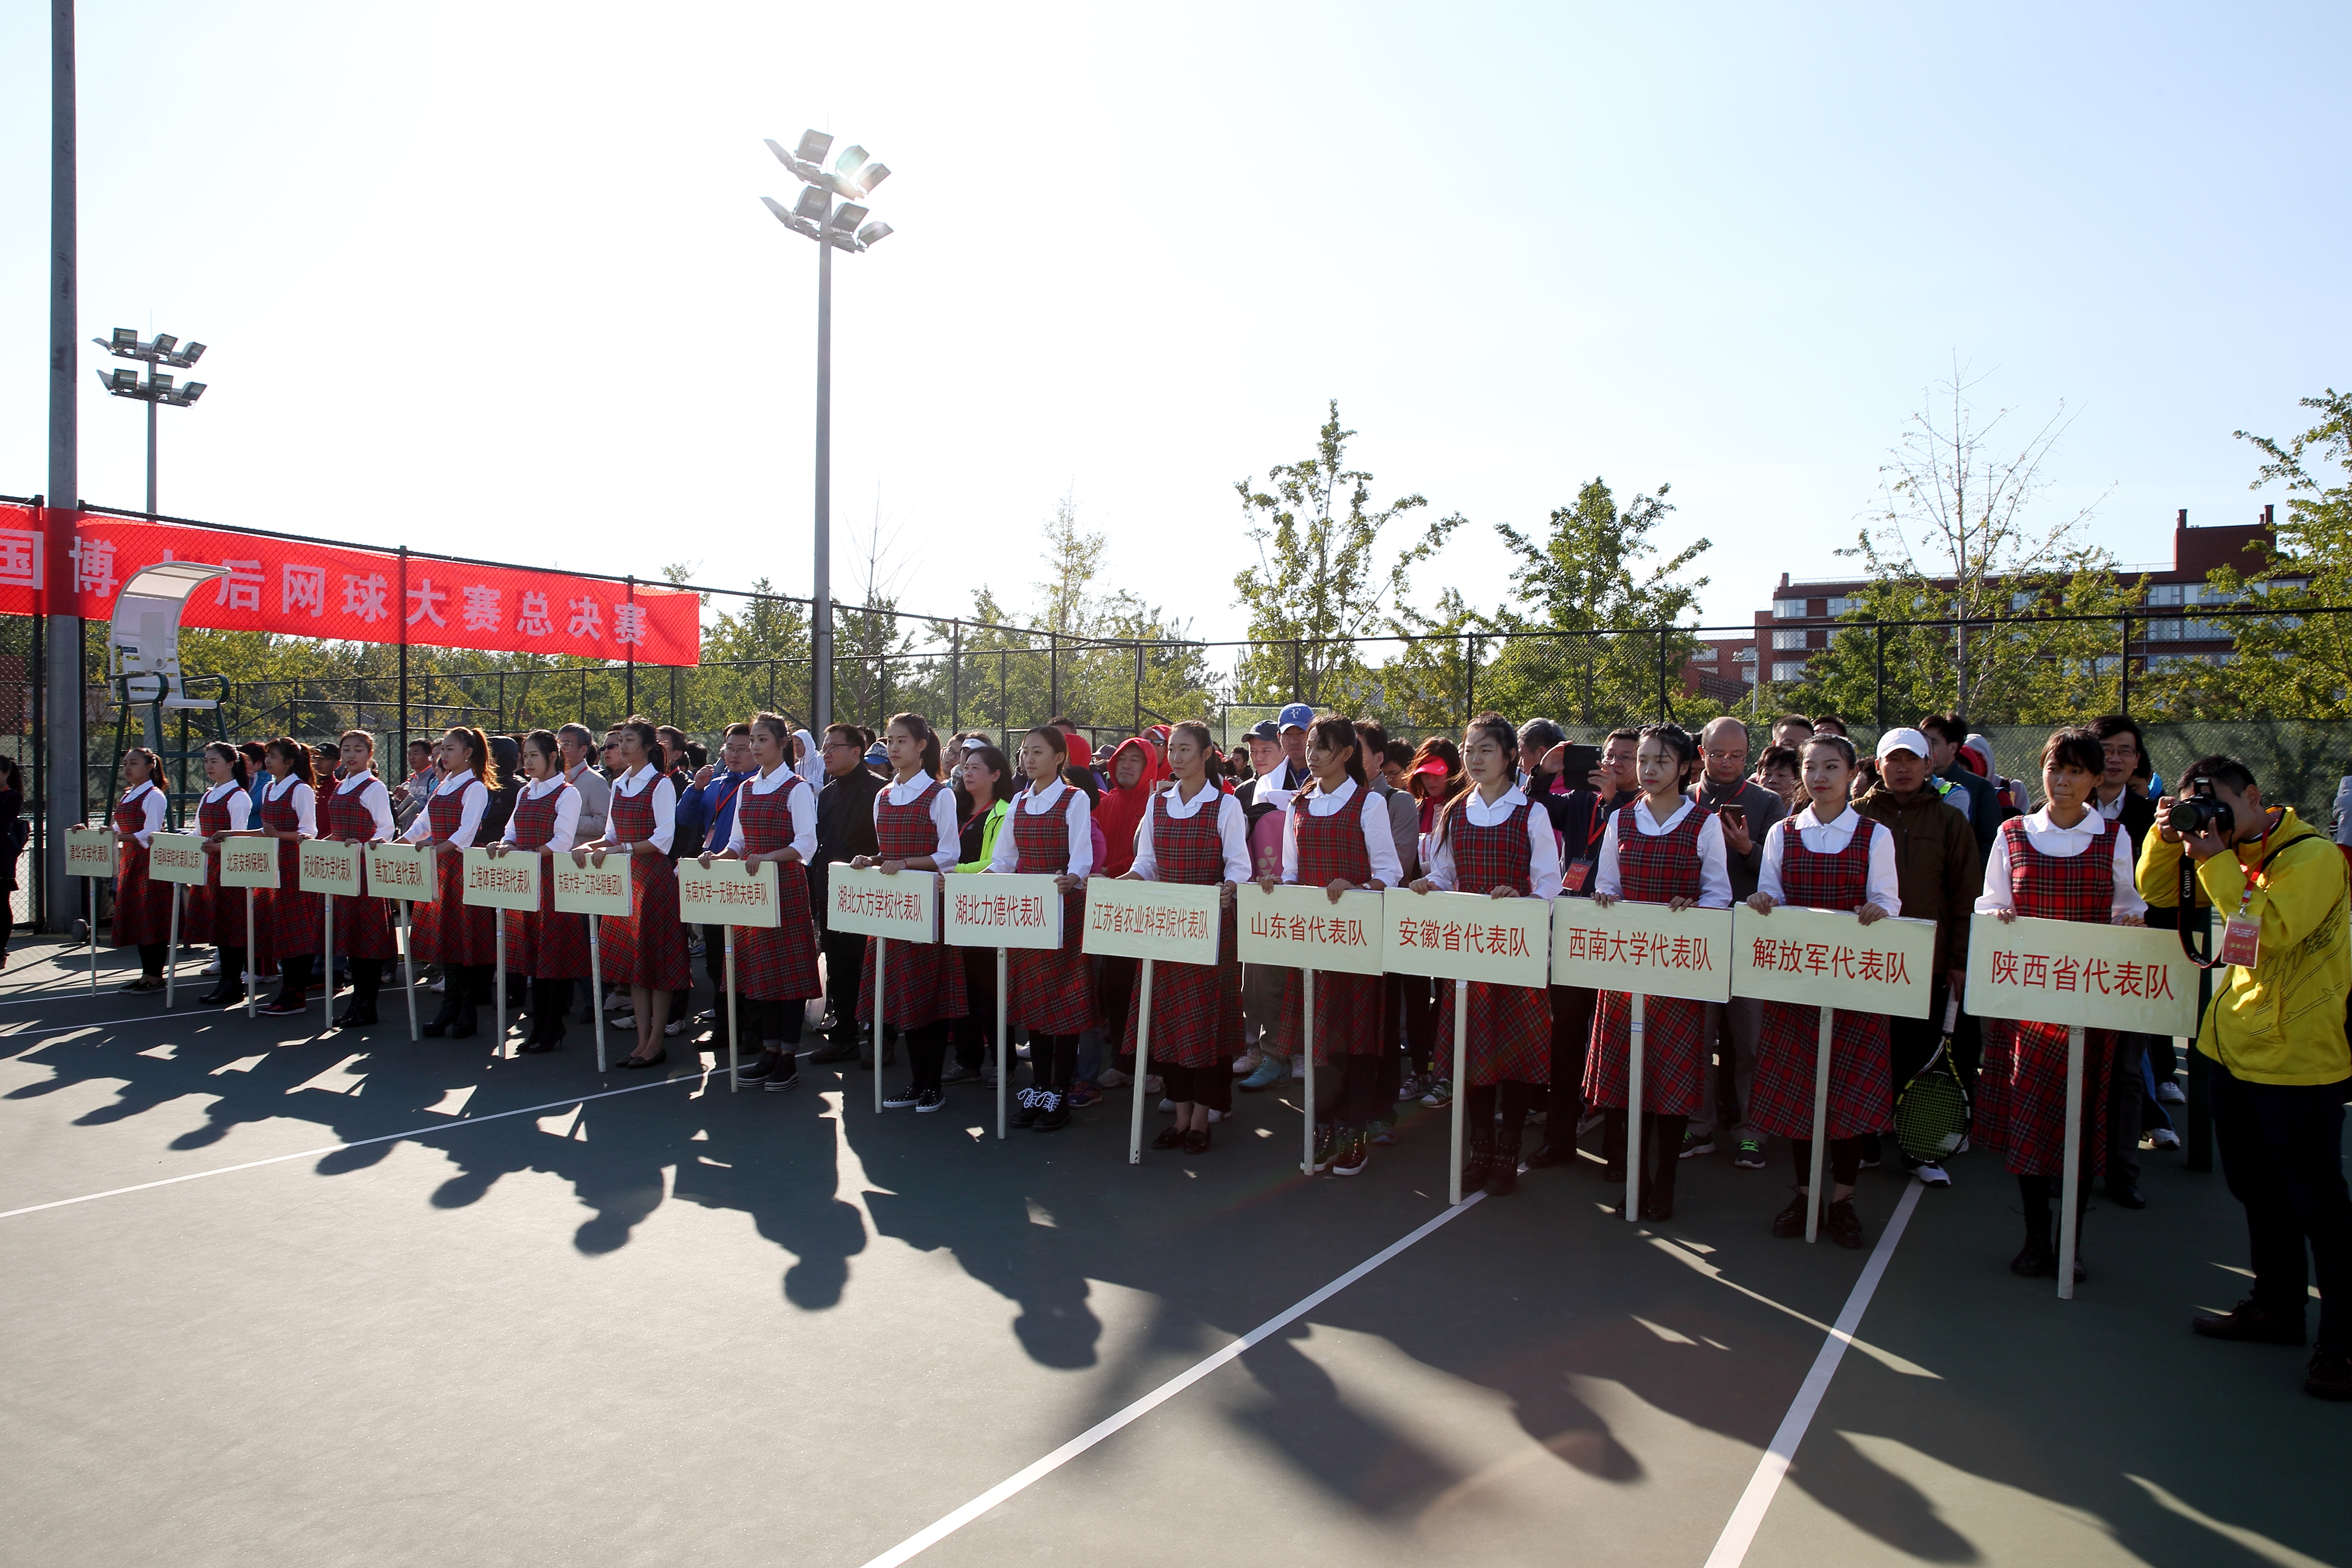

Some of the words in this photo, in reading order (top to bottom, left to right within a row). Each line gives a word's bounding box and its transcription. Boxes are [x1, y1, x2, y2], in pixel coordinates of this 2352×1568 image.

[0, 528, 646, 647] 国博后网球大赛总决赛
[69, 844, 110, 863] 清华大学代表队
[226, 852, 271, 873] 北京安邦保险队
[303, 854, 352, 882] 河北师范大学代表队
[374, 858, 424, 887] 黑龙江省代表队
[469, 864, 532, 895] 上海体育学院代表队
[2183, 870, 2191, 898] Canon
[837, 883, 923, 923] 湖北大方学校代表队
[955, 893, 1047, 928] 湖北力德代表队
[1092, 901, 1209, 940] 江苏省农业科学院代表队
[1250, 911, 1368, 947] 山东省代表队
[1398, 917, 1531, 958] 安徽省代表队
[1568, 927, 1713, 972] 西南大学代表队
[1752, 936, 1911, 986] 解放军代表队
[1990, 949, 2175, 1001] 陕西省代表队
